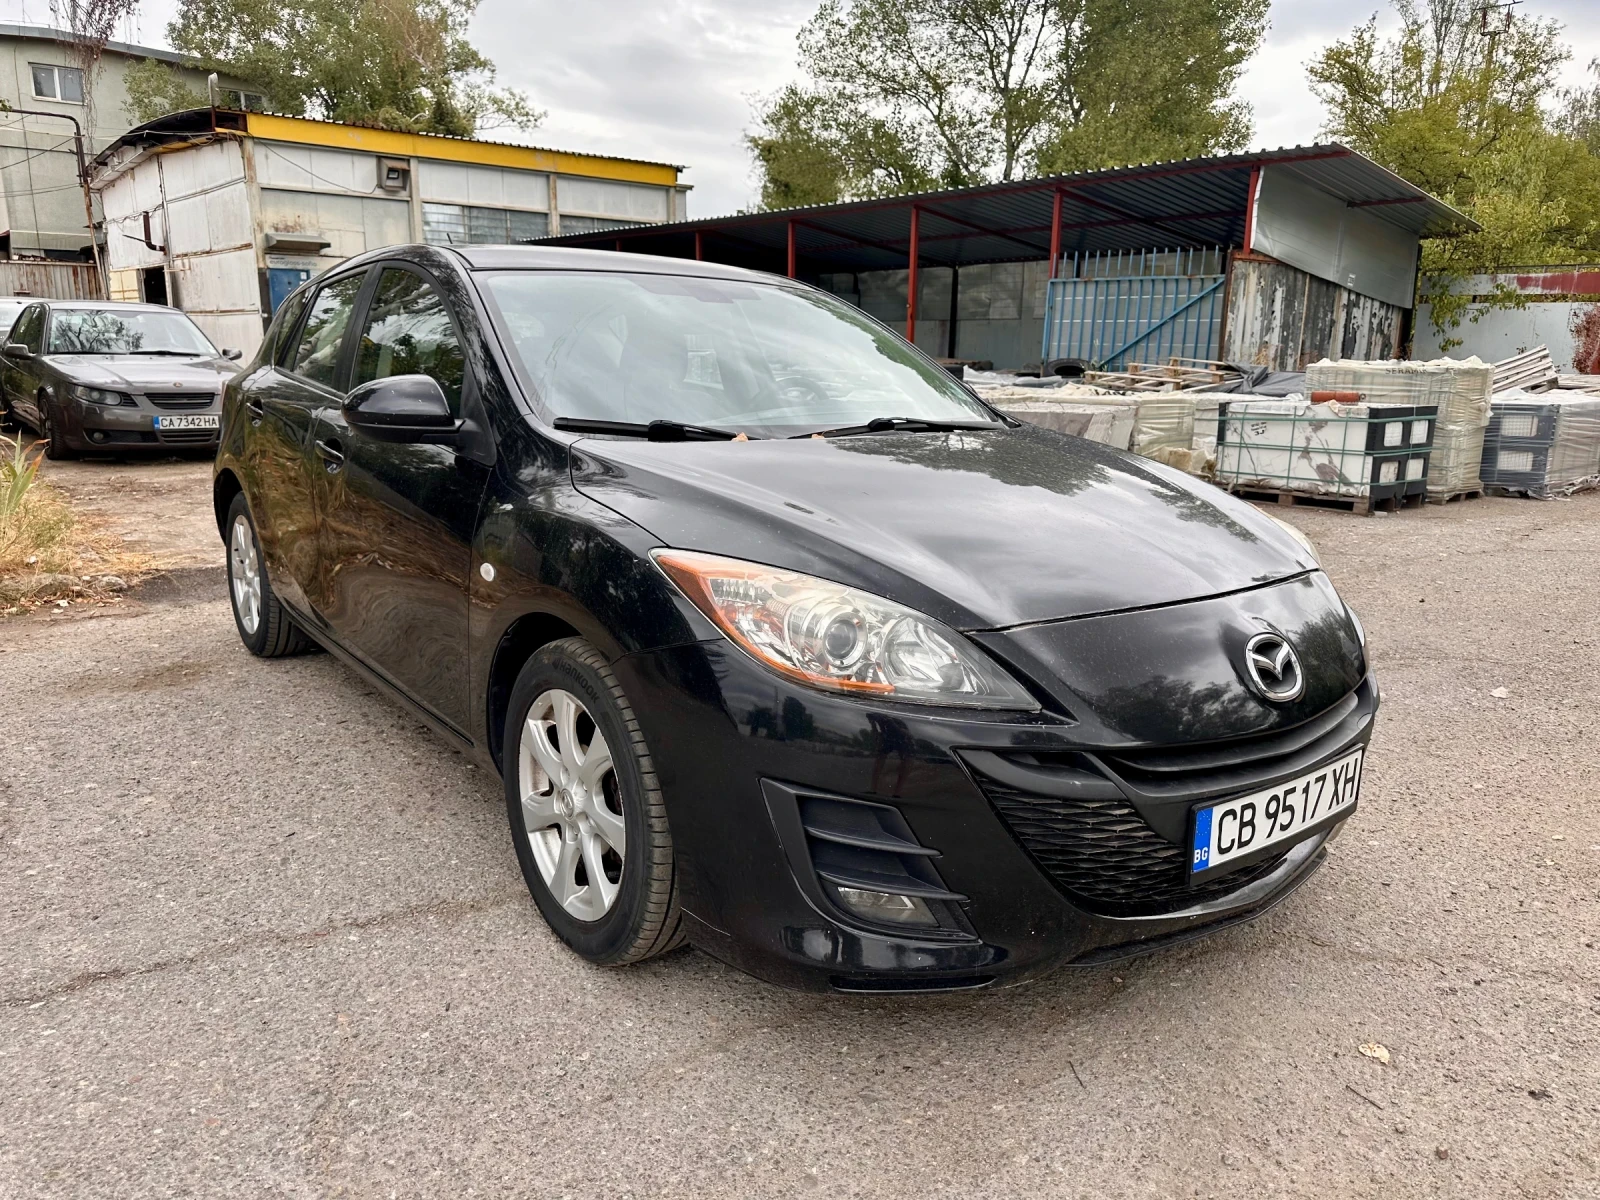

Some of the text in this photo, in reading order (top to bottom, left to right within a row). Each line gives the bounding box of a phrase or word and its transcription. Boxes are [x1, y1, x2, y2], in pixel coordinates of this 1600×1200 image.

[160, 418, 175, 428] CA
[177, 417, 202, 427] 7342
[203, 416, 217, 426] HA
[1217, 757, 1359, 855] CB 9517 XH
[1193, 847, 1209, 864] BG
